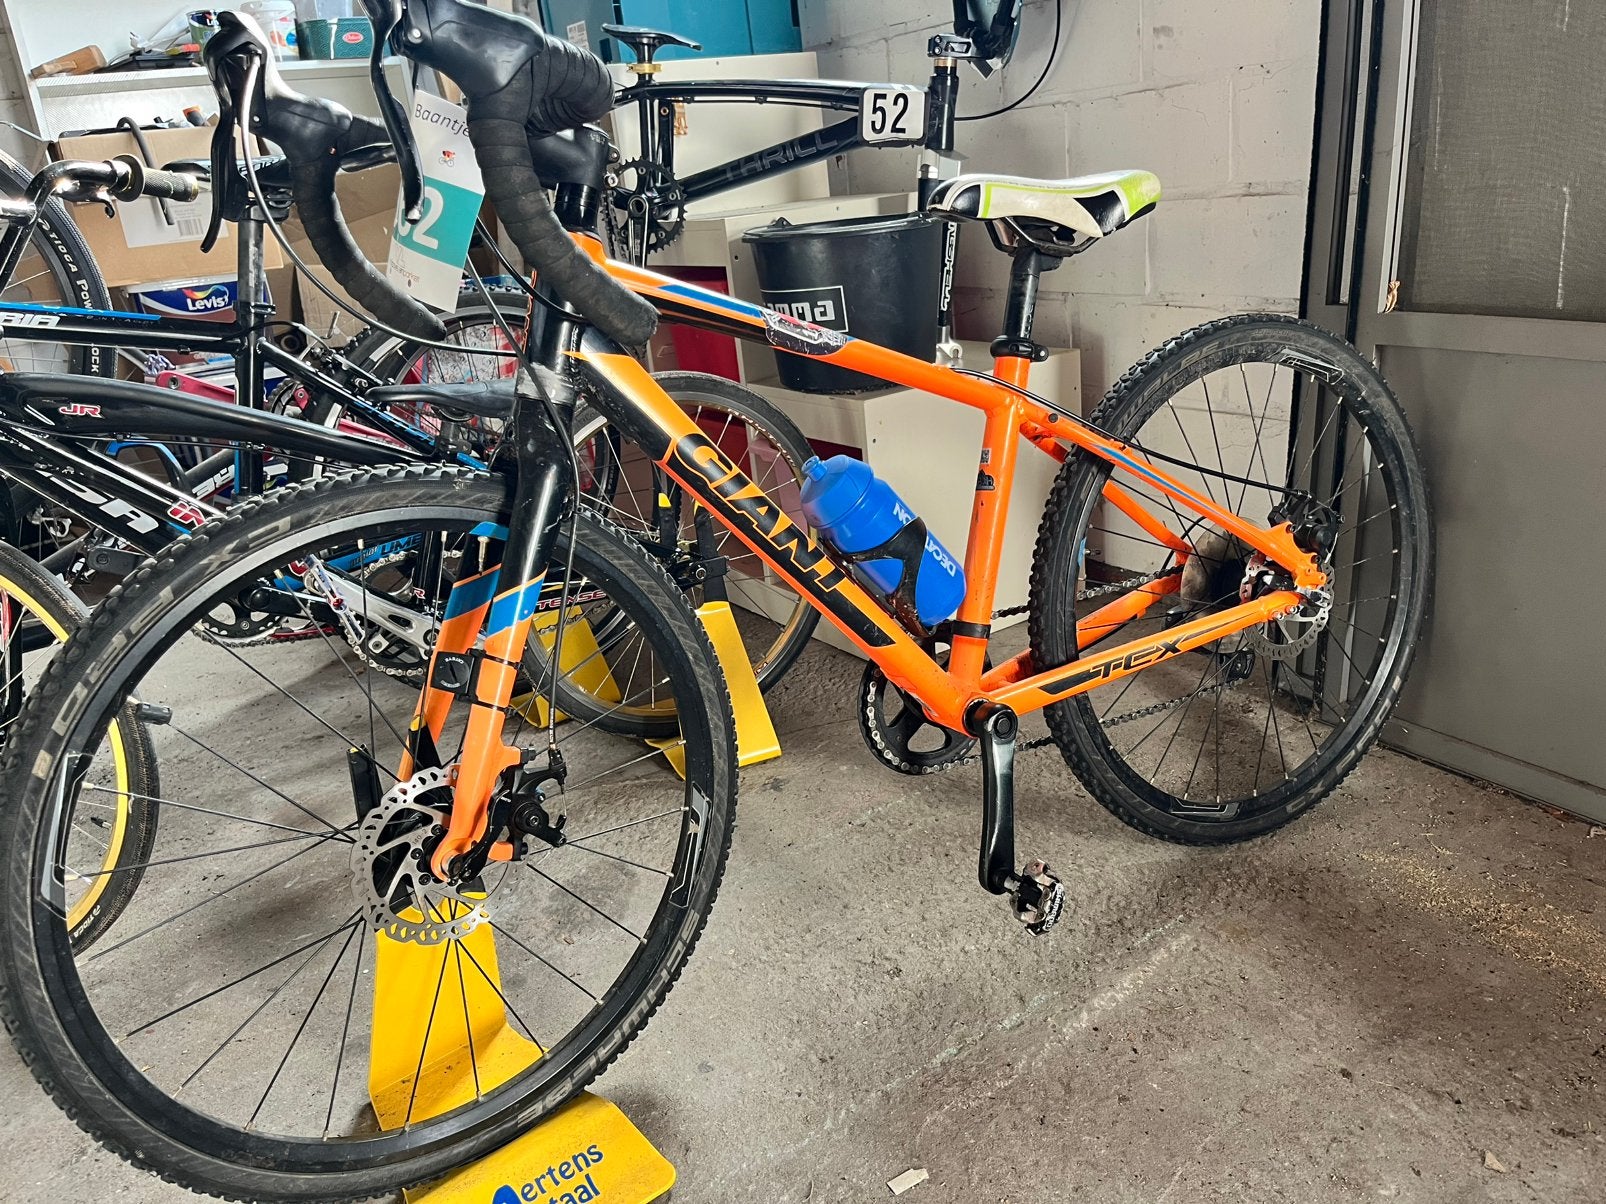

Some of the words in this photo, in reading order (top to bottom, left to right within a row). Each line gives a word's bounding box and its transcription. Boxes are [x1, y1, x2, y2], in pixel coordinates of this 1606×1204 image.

[870, 92, 910, 135] 52
[719, 131, 838, 182] THRILL
[186, 296, 226, 312] Levis
[59, 402, 103, 419] JR
[674, 432, 847, 593] GIANT
[893, 502, 957, 577] DECATON
[1091, 634, 1188, 679] TCX
[517, 909, 700, 1128] SCHWALBE
[493, 1144, 604, 1204] ertens
